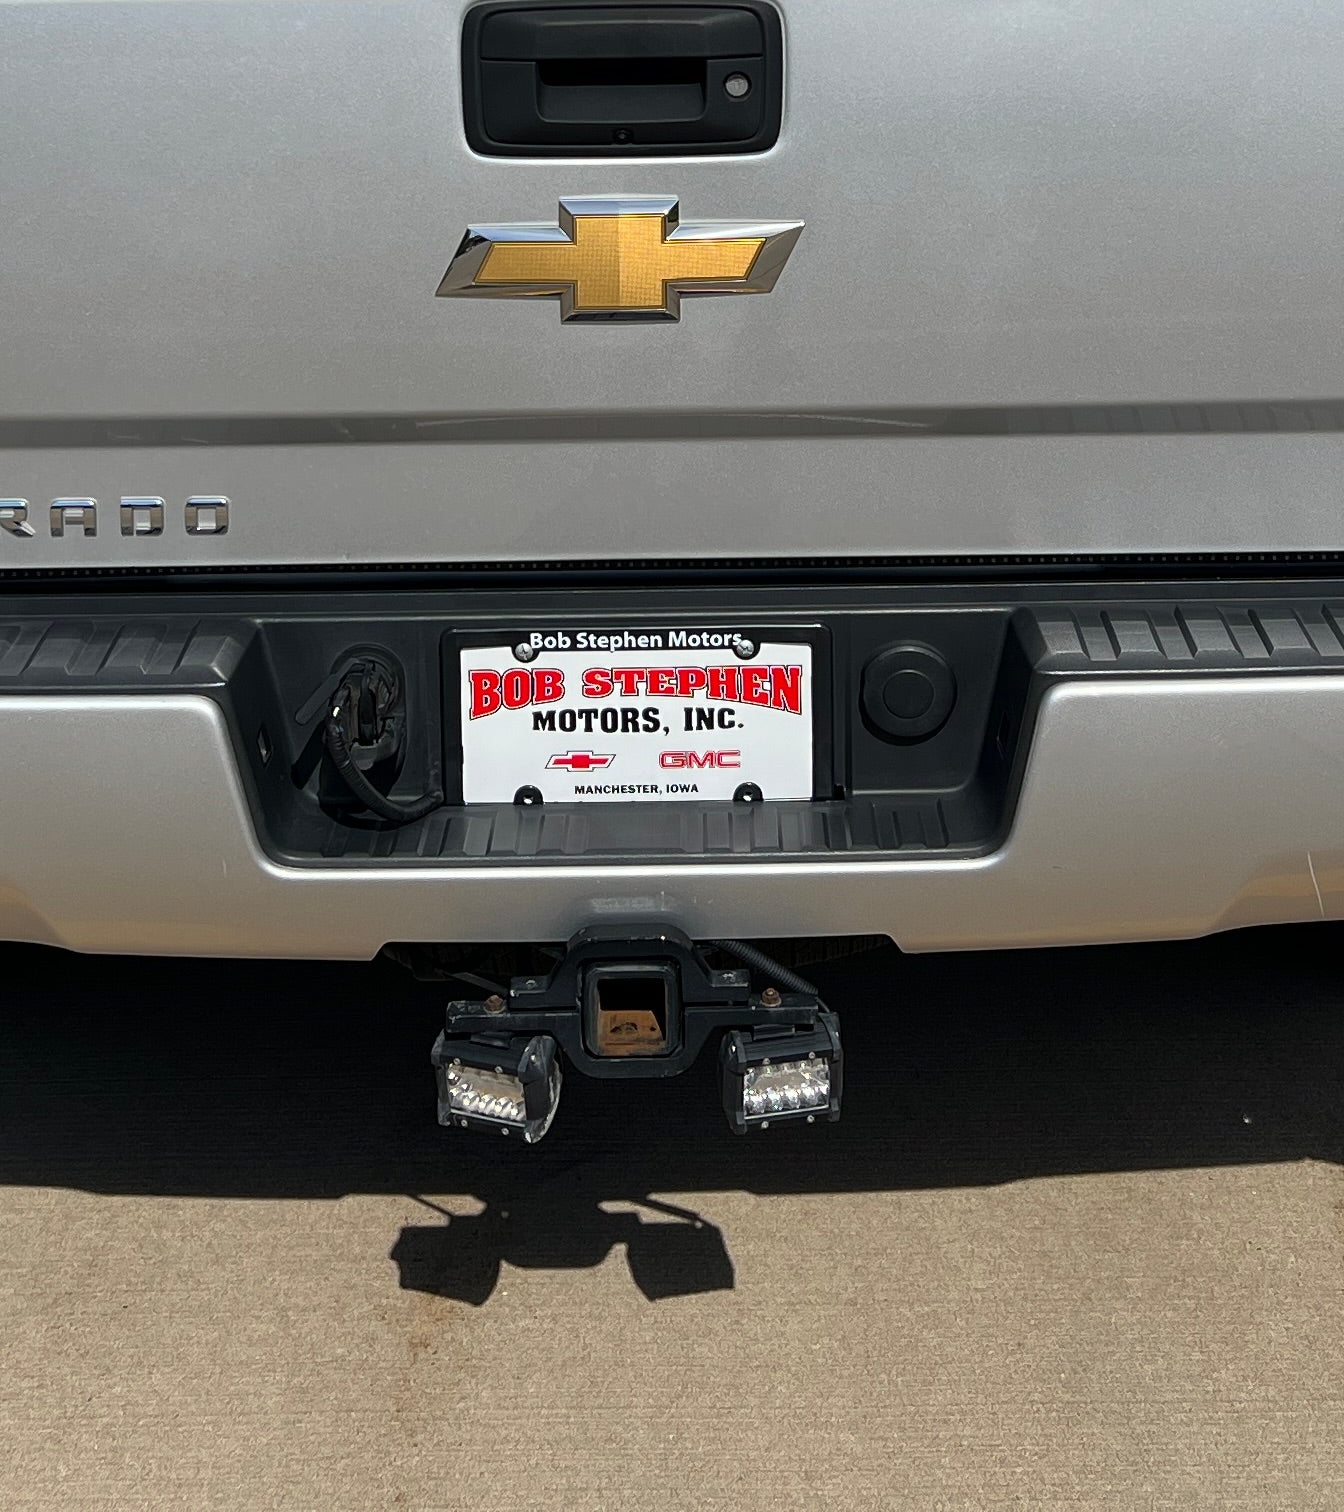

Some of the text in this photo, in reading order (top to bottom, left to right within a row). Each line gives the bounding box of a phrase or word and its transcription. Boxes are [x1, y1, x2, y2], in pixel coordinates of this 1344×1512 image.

[530, 632, 742, 652] Bob Stephen Motors
[469, 664, 803, 720] BOB STEPHEN
[532, 707, 744, 736] MOTORS, INC.
[659, 750, 741, 769] GMC
[574, 784, 699, 796] MANCHESTER, IOWA
